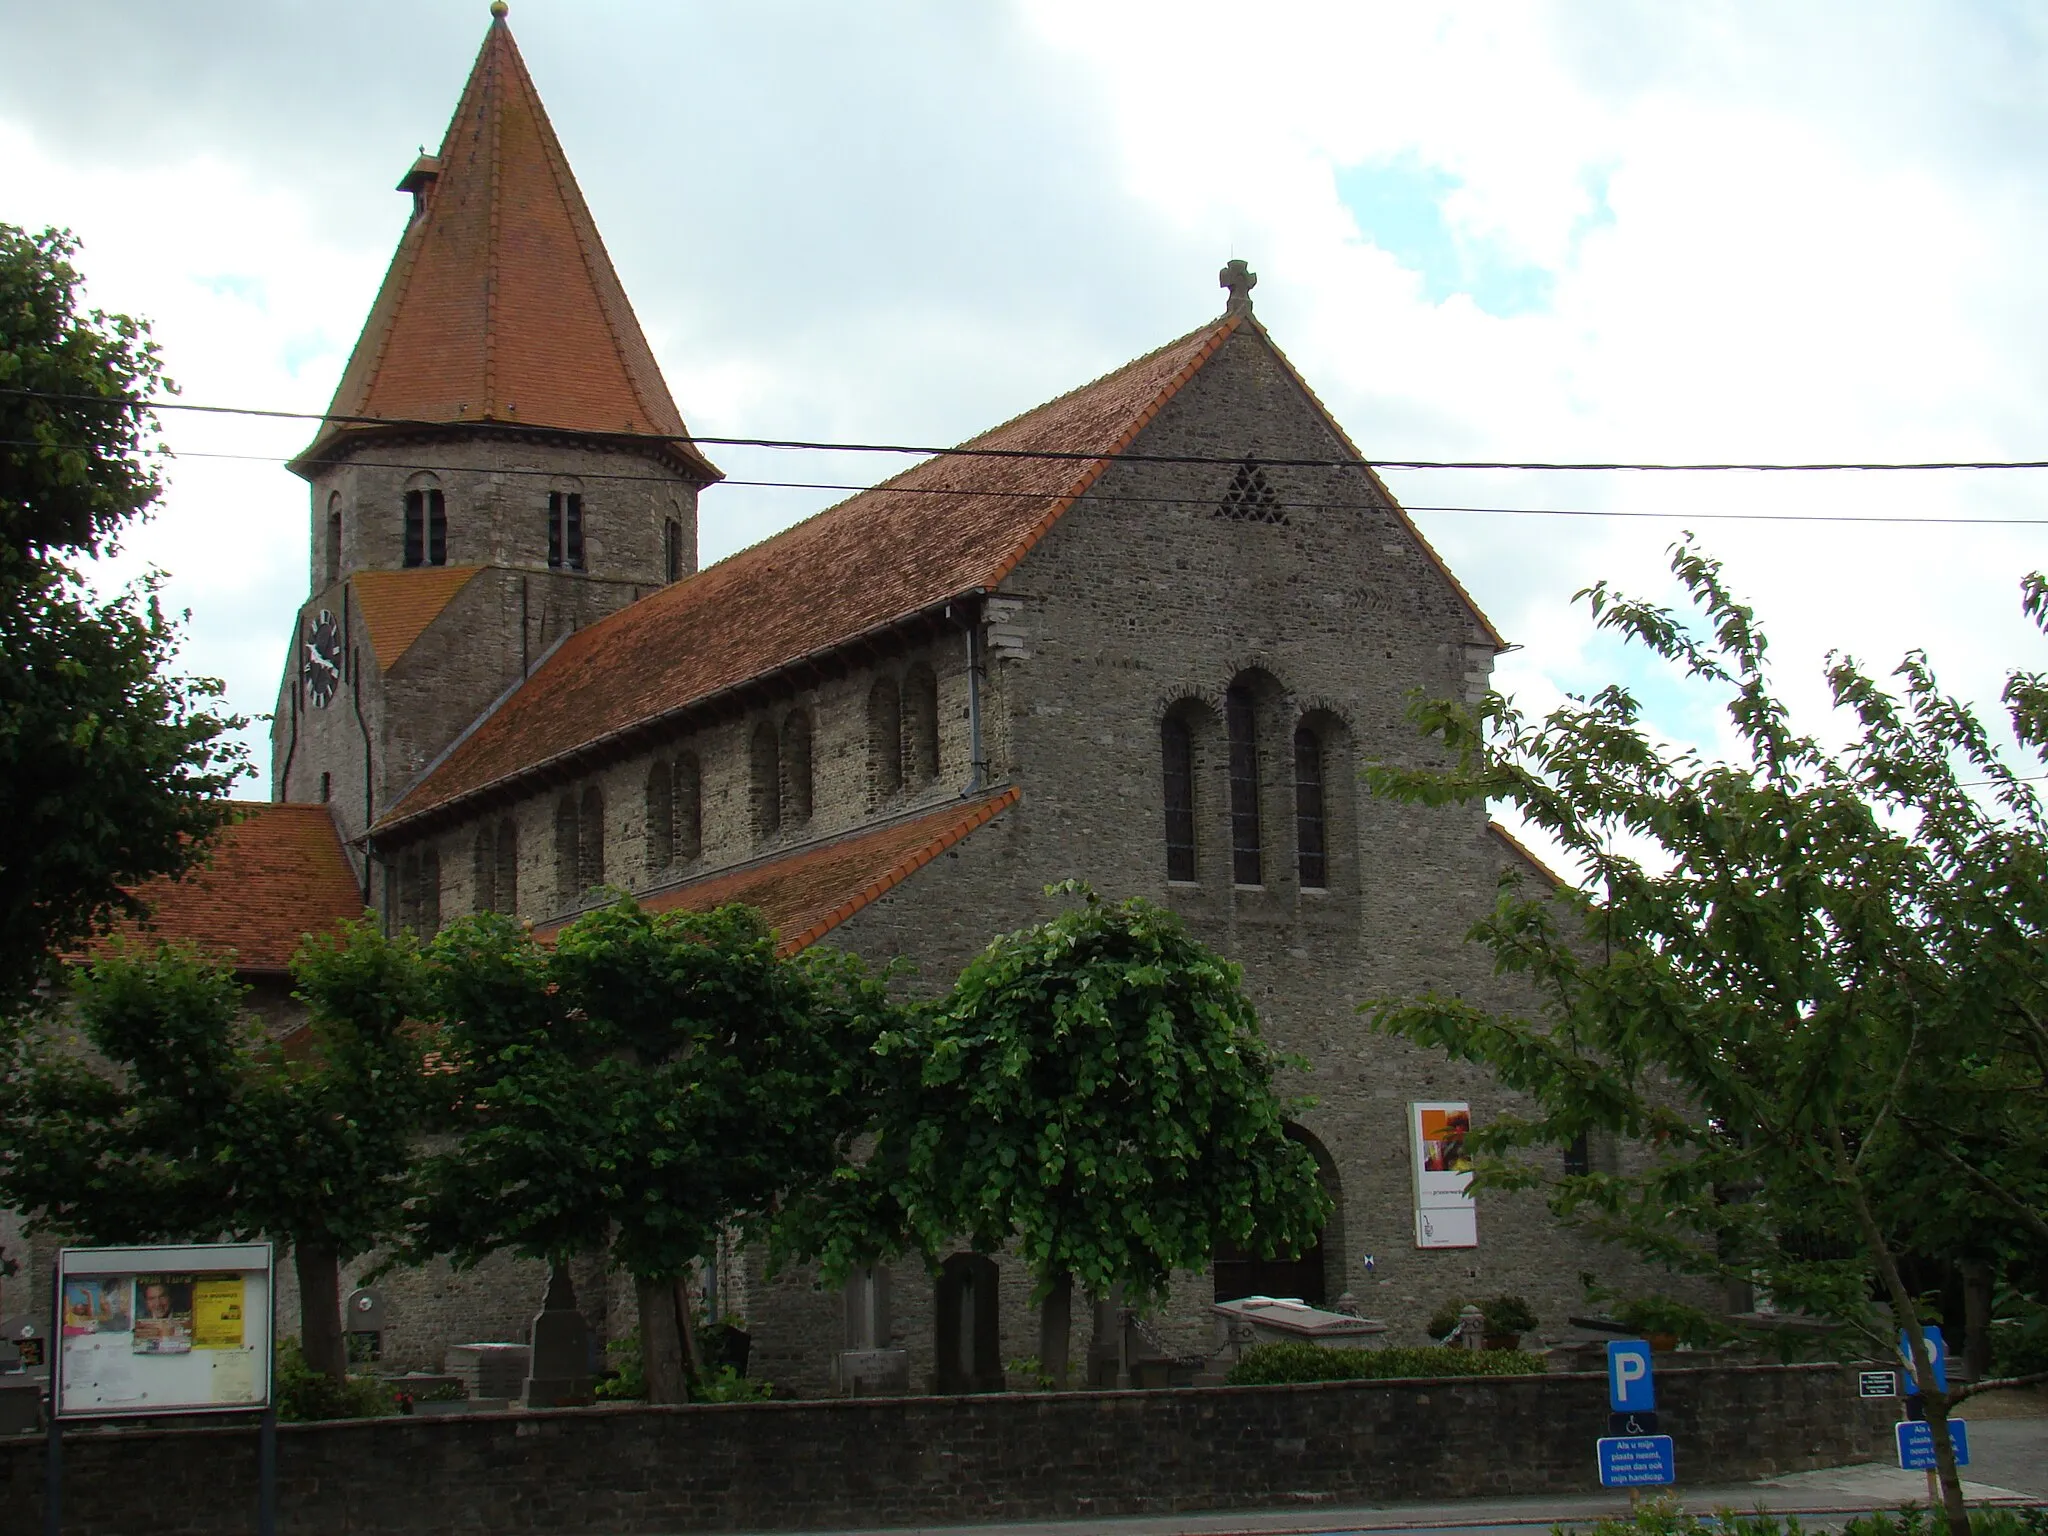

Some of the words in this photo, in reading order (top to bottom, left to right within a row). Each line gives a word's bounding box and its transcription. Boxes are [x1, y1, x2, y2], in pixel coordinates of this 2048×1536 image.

[1615, 1353, 1645, 1401] P
[1616, 1441, 1630, 1450] Als
[1638, 1440, 1654, 1450] mijn
[1611, 1451, 1634, 1462] plaats
[1633, 1462, 1648, 1471] dan
[1648, 1461, 1663, 1470] ook
[1611, 1474, 1628, 1483] mijn
